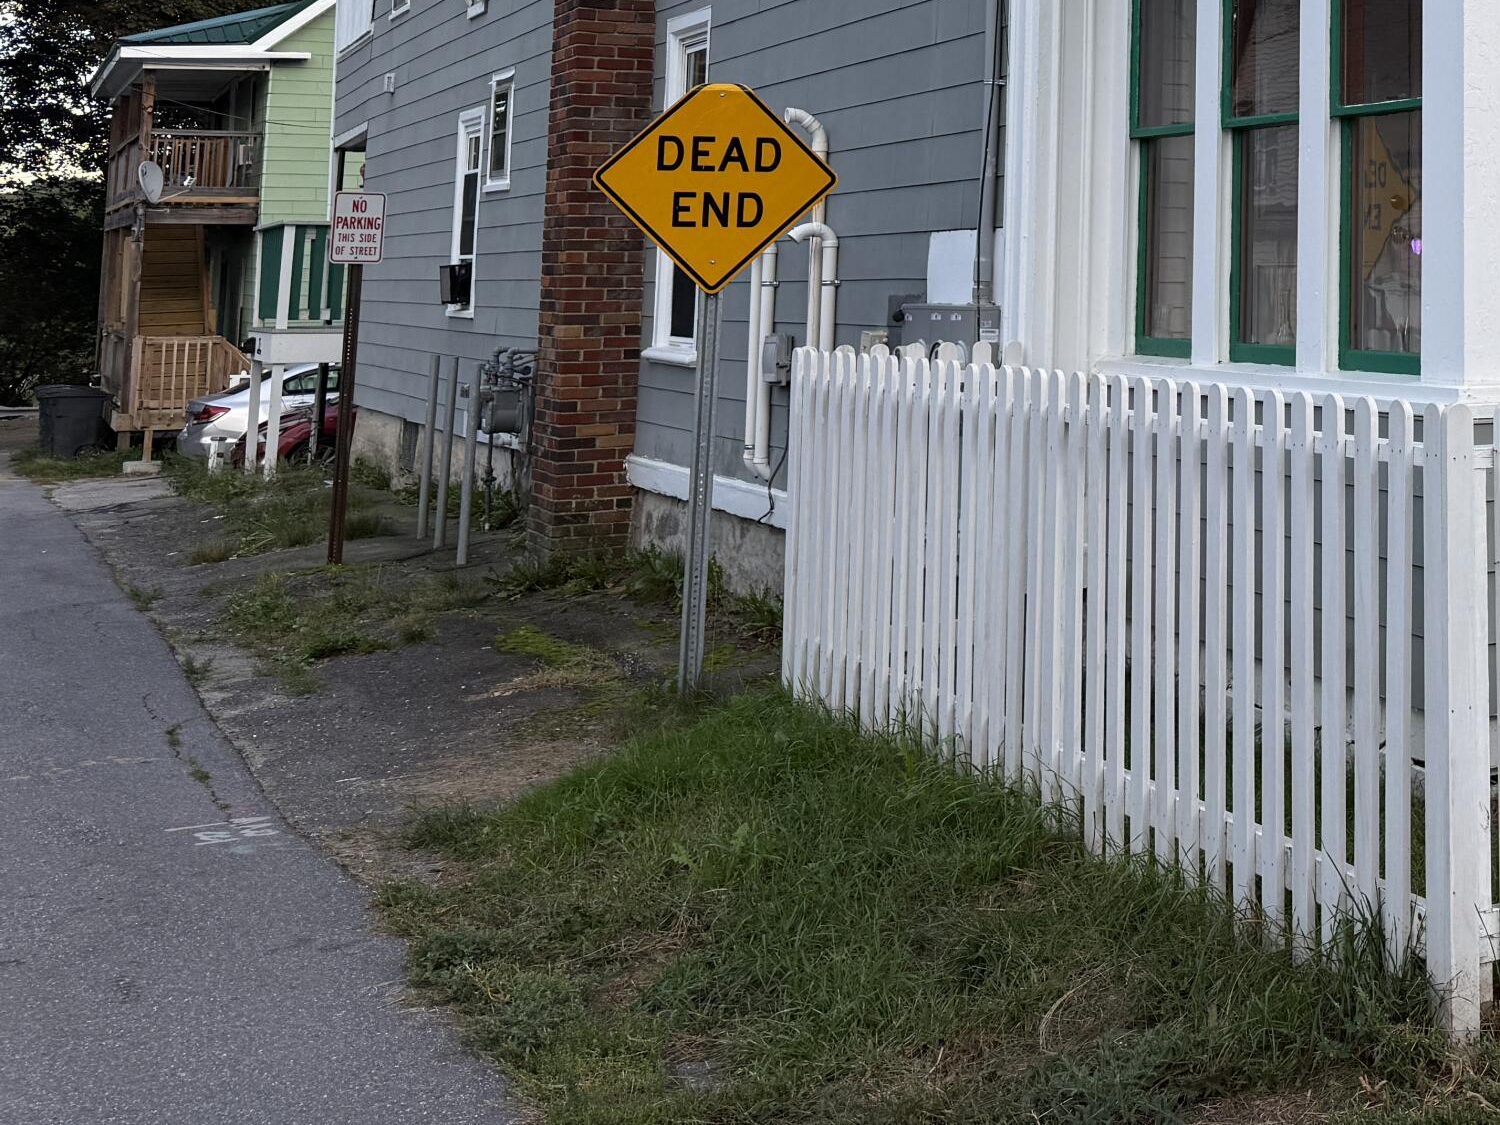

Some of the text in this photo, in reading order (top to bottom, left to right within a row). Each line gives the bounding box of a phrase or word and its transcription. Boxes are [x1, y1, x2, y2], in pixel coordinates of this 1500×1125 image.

[657, 135, 782, 172] DEAD
[352, 199, 368, 213] NO
[671, 192, 763, 227] END
[336, 216, 381, 230] PARKING
[338, 233, 377, 243] THIS SIDE
[335, 246, 378, 256] OF STREET
